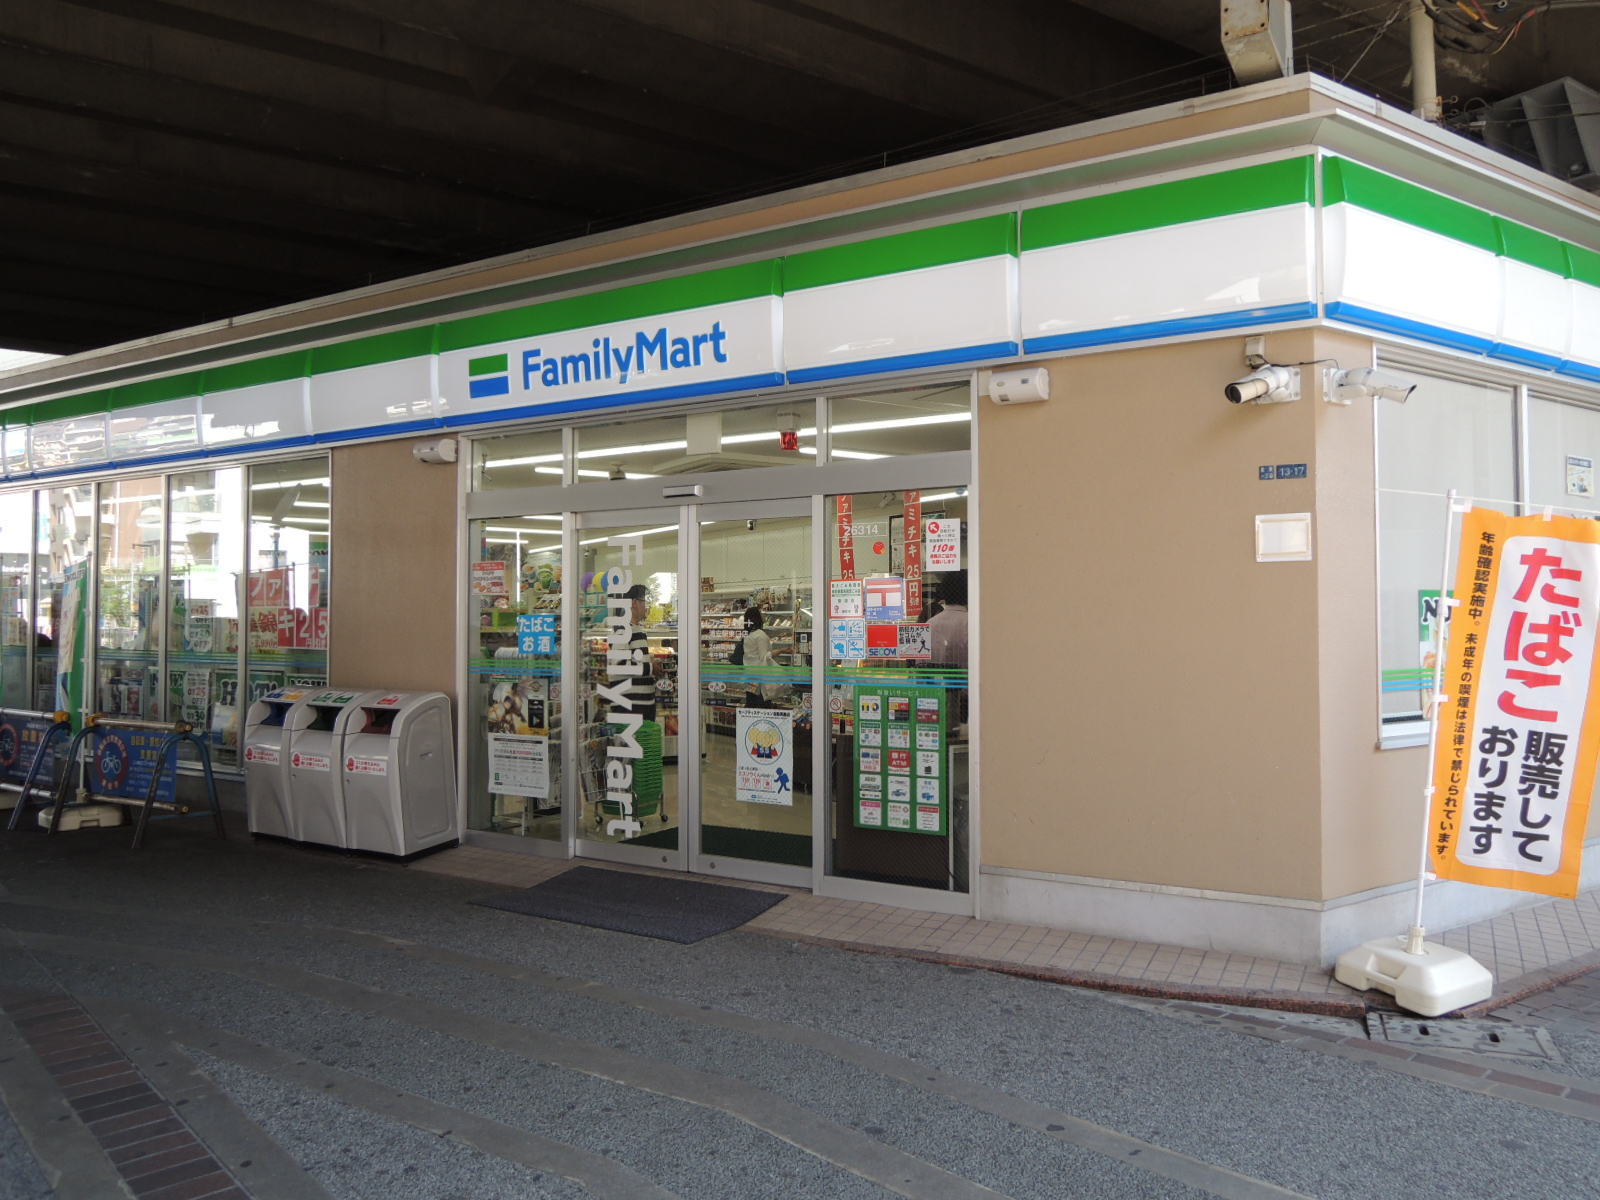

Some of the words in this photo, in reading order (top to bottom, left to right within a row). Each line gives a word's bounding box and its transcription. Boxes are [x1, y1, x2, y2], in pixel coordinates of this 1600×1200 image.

[522, 321, 727, 390] FamilyMart
[844, 524, 879, 536] 26314
[519, 617, 554, 632] たばこ
[1468, 531, 1496, 627] 年齢確認実施中。
[523, 636, 551, 652] お酒
[868, 647, 897, 656] SECOM
[1497, 547, 1582, 722] たばこ
[596, 536, 644, 839] FamilyMart
[1436, 632, 1478, 861] 未成年の喫煙は法律で禁じられています。
[1469, 725, 1519, 855] おります
[1512, 730, 1568, 863] 販売して
